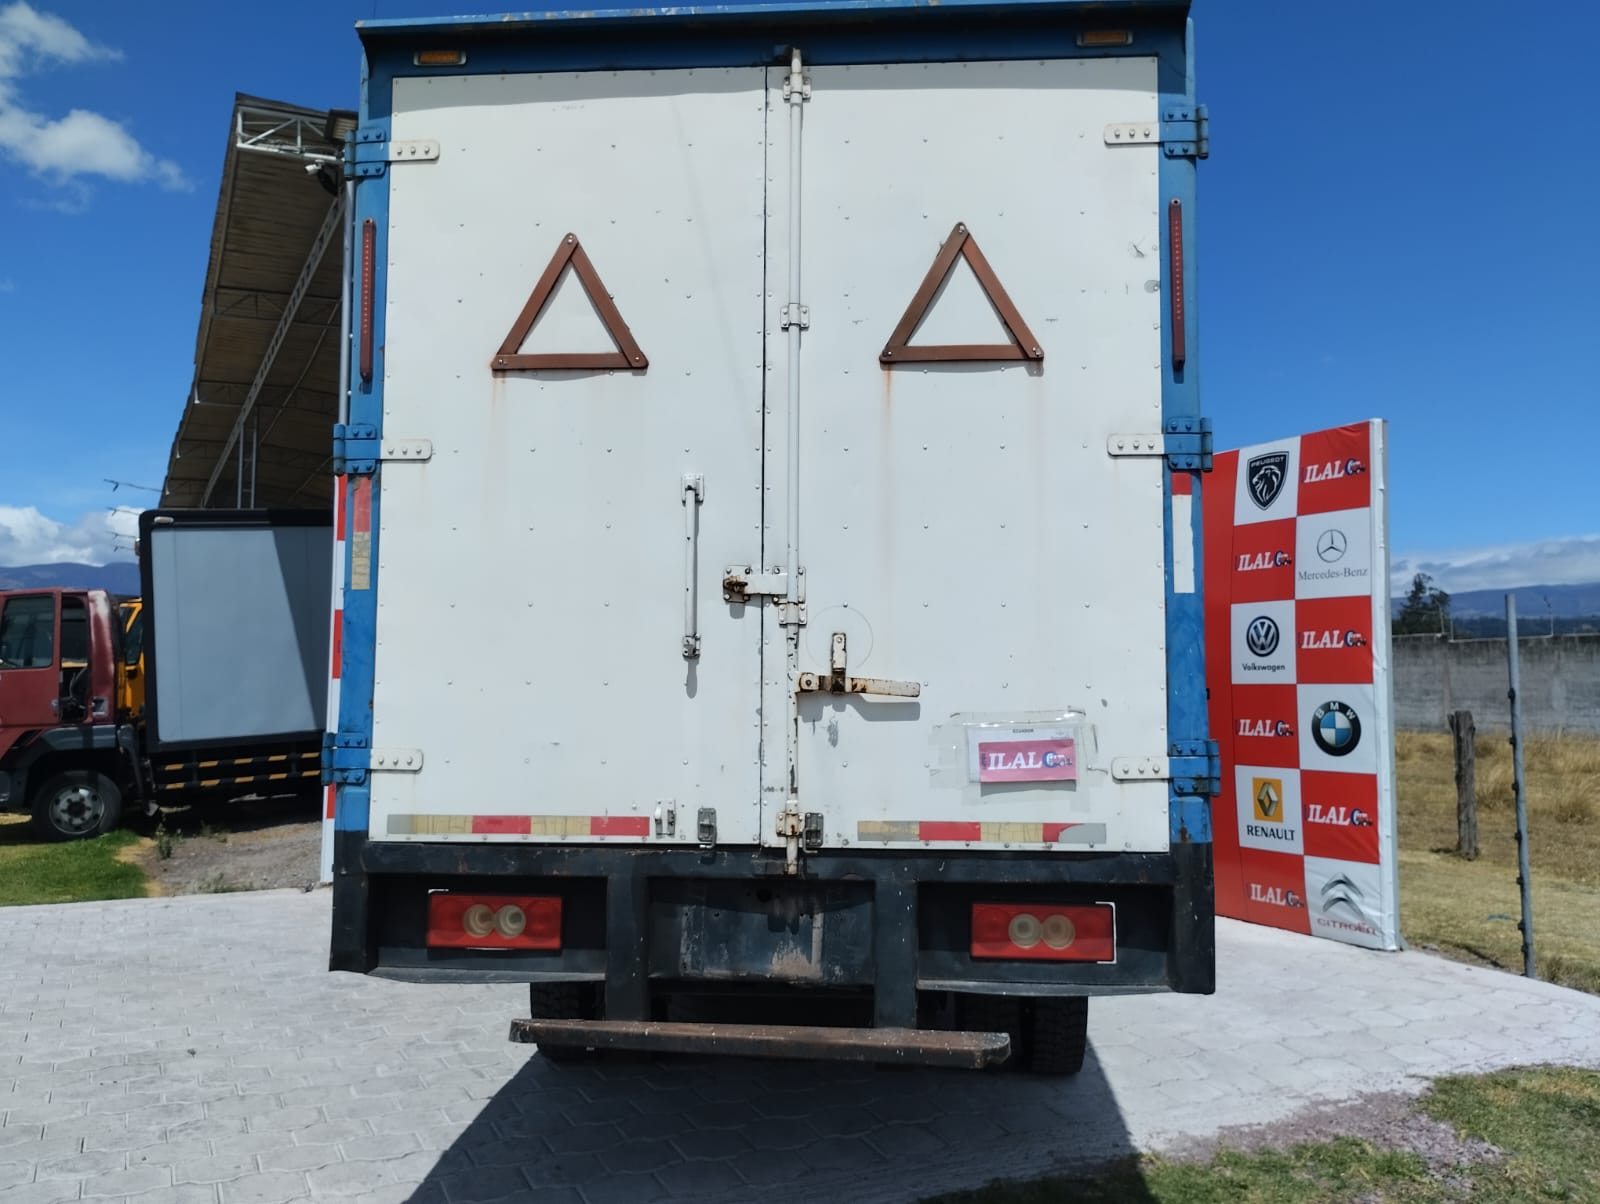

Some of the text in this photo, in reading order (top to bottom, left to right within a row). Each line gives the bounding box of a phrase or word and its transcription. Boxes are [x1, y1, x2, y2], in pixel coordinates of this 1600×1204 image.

[1251, 456, 1285, 468] PEUGEOT
[1298, 567, 1368, 581] Mercedes-Benz
[1242, 662, 1286, 672] Volkswagen
[1315, 702, 1356, 719] BMW
[1246, 824, 1295, 842] RENAULT
